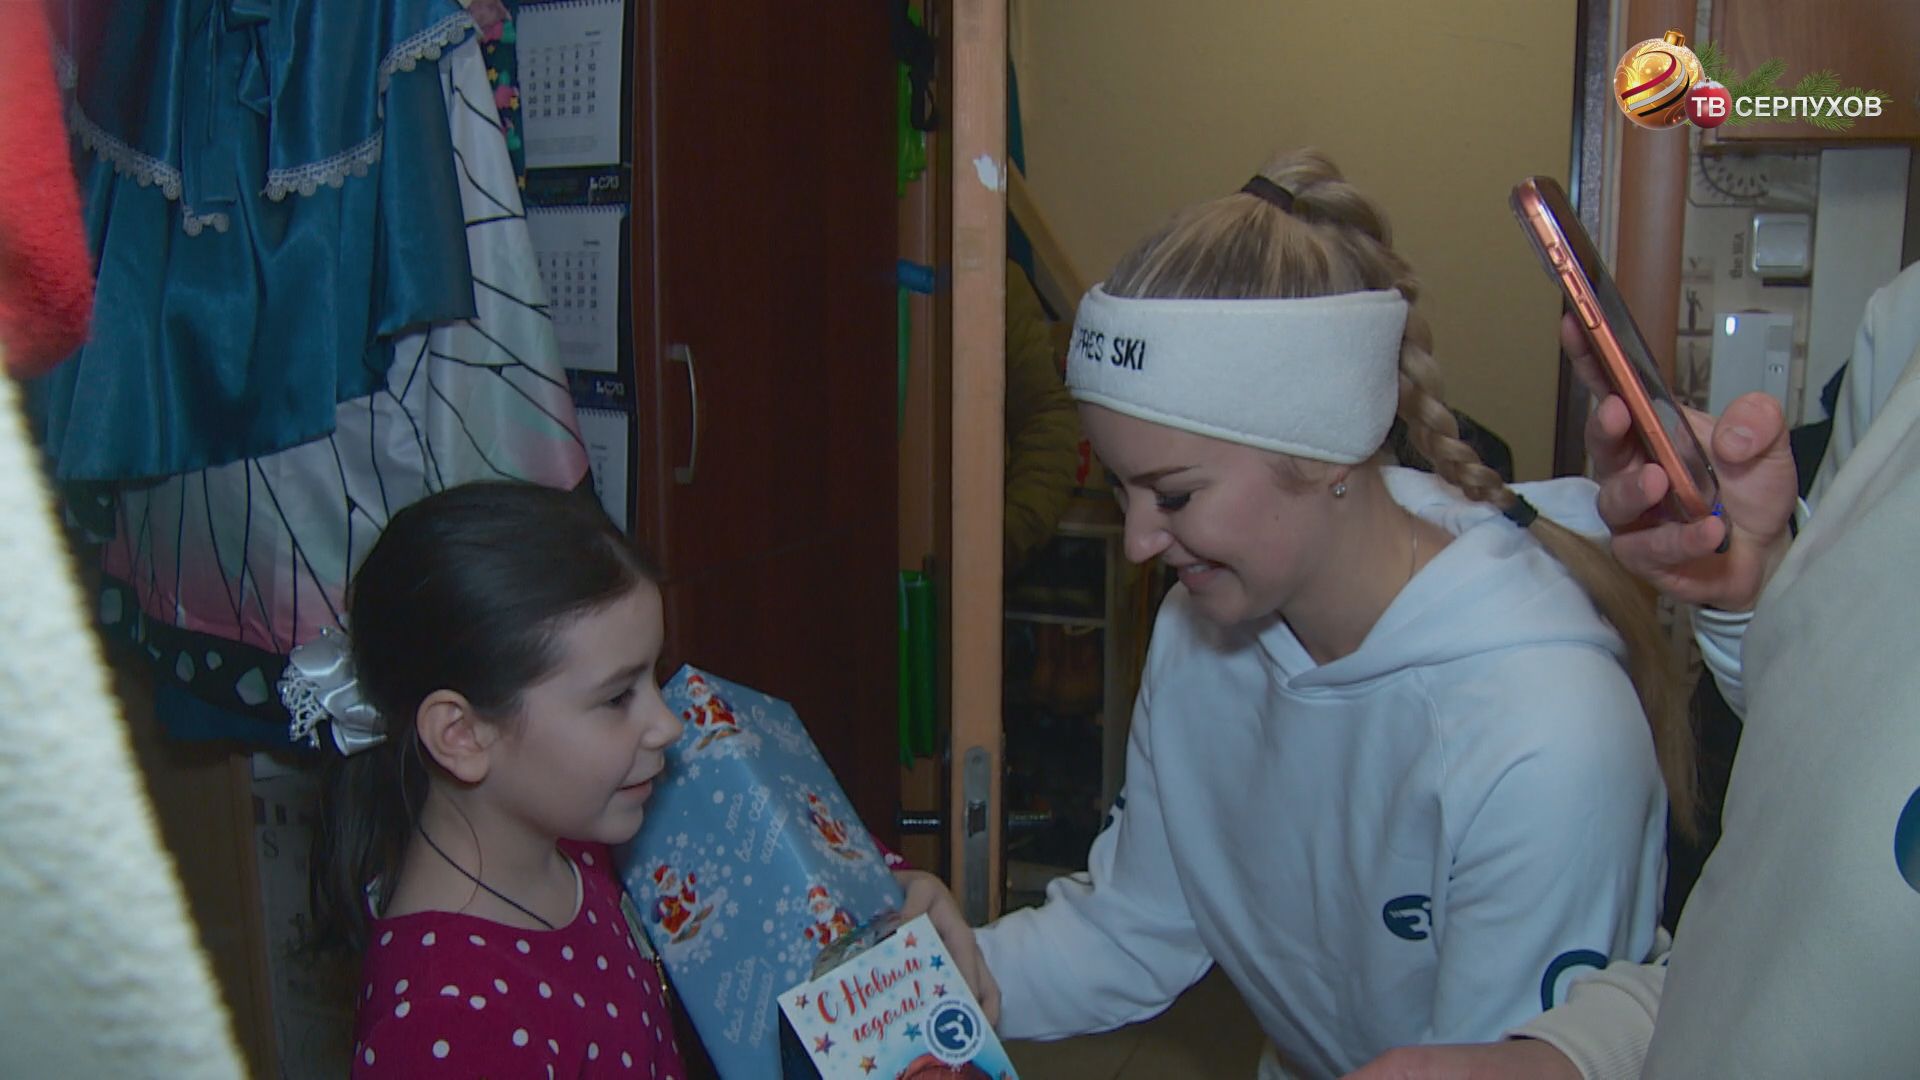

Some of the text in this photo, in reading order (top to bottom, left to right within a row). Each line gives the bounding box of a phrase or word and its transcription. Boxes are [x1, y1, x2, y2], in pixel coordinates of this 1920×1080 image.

[1111, 337, 1146, 371] SKI
[817, 958, 921, 1024] С Новым
[853, 980, 925, 1042] годом!
